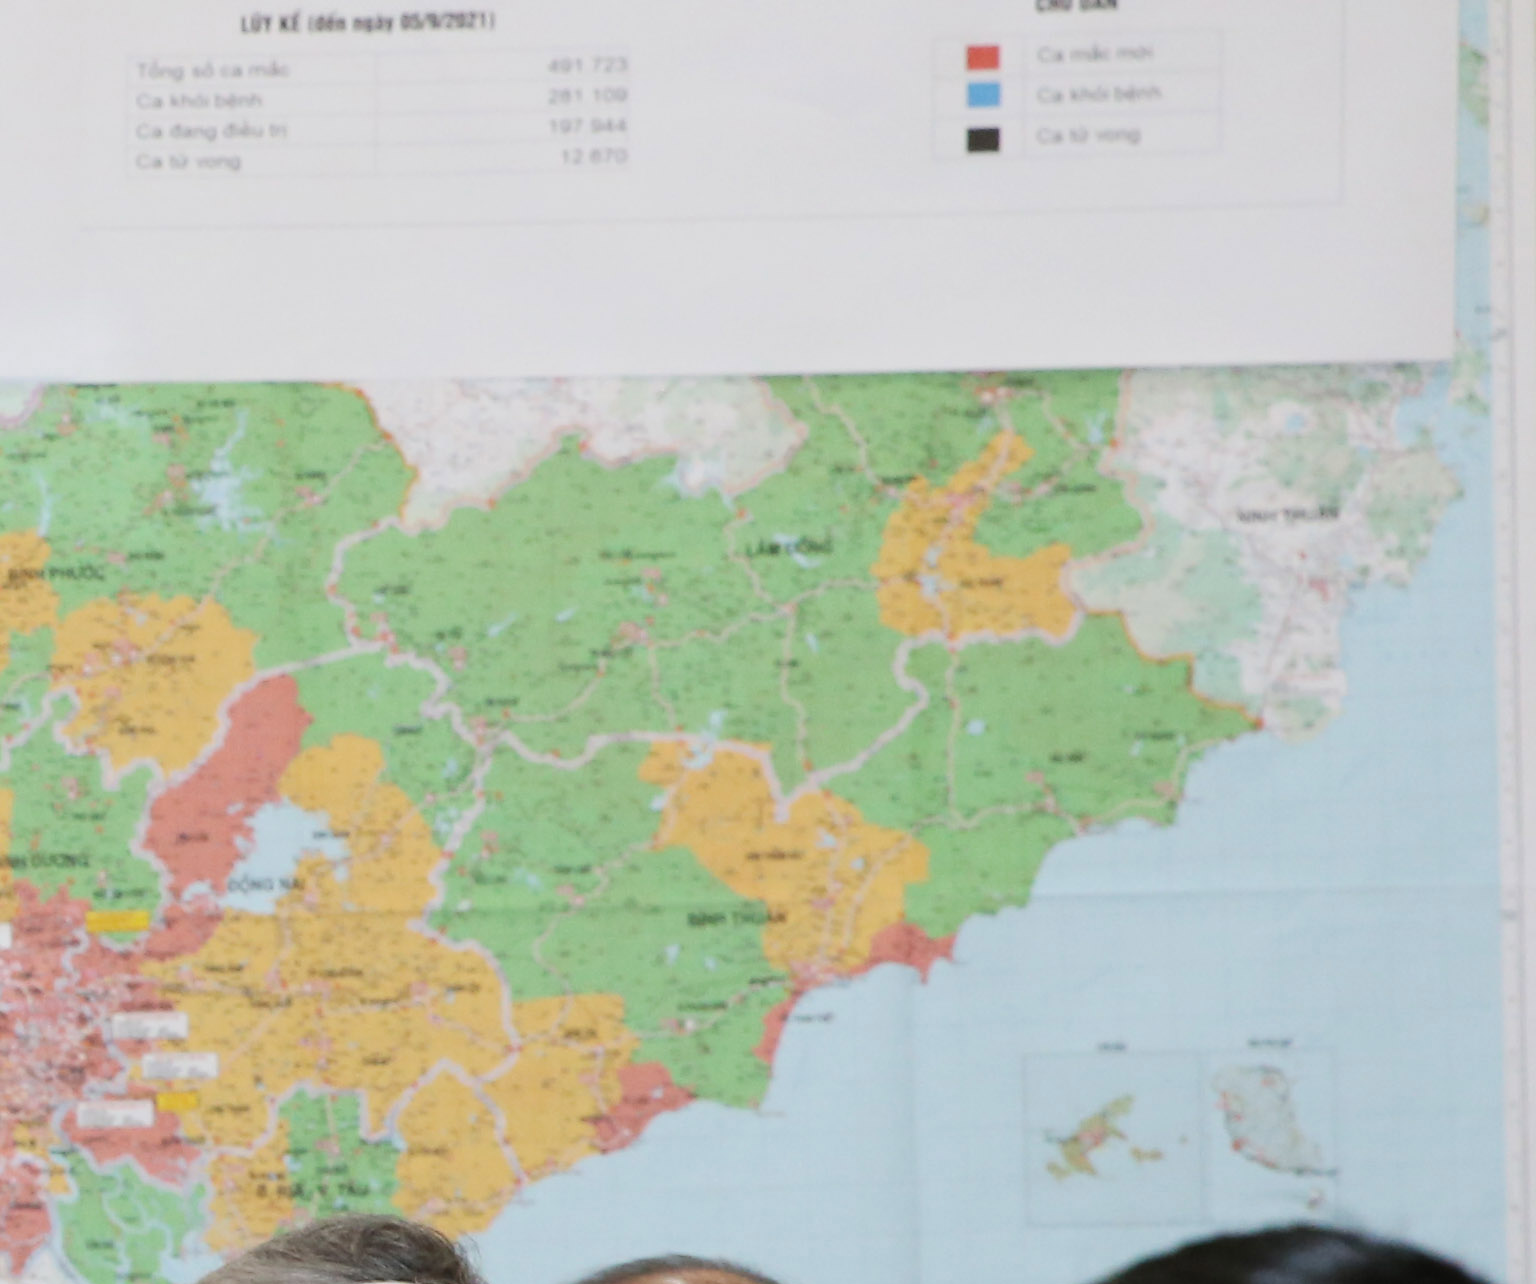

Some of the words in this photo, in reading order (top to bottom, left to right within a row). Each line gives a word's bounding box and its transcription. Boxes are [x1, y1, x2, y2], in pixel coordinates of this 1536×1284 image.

[241, 13, 272, 34] LŨY
[278, 8, 300, 33] KẾ
[352, 13, 394, 34] ngày
[1037, 46, 1063, 63] Ca
[220, 64, 243, 78] ca
[136, 92, 164, 109] Ca
[1036, 86, 1063, 103] Ca
[136, 122, 164, 139] Ca
[1036, 127, 1063, 144] Ca
[1096, 127, 1141, 145] vong
[136, 152, 164, 170] Ca
[195, 154, 241, 172] vong
